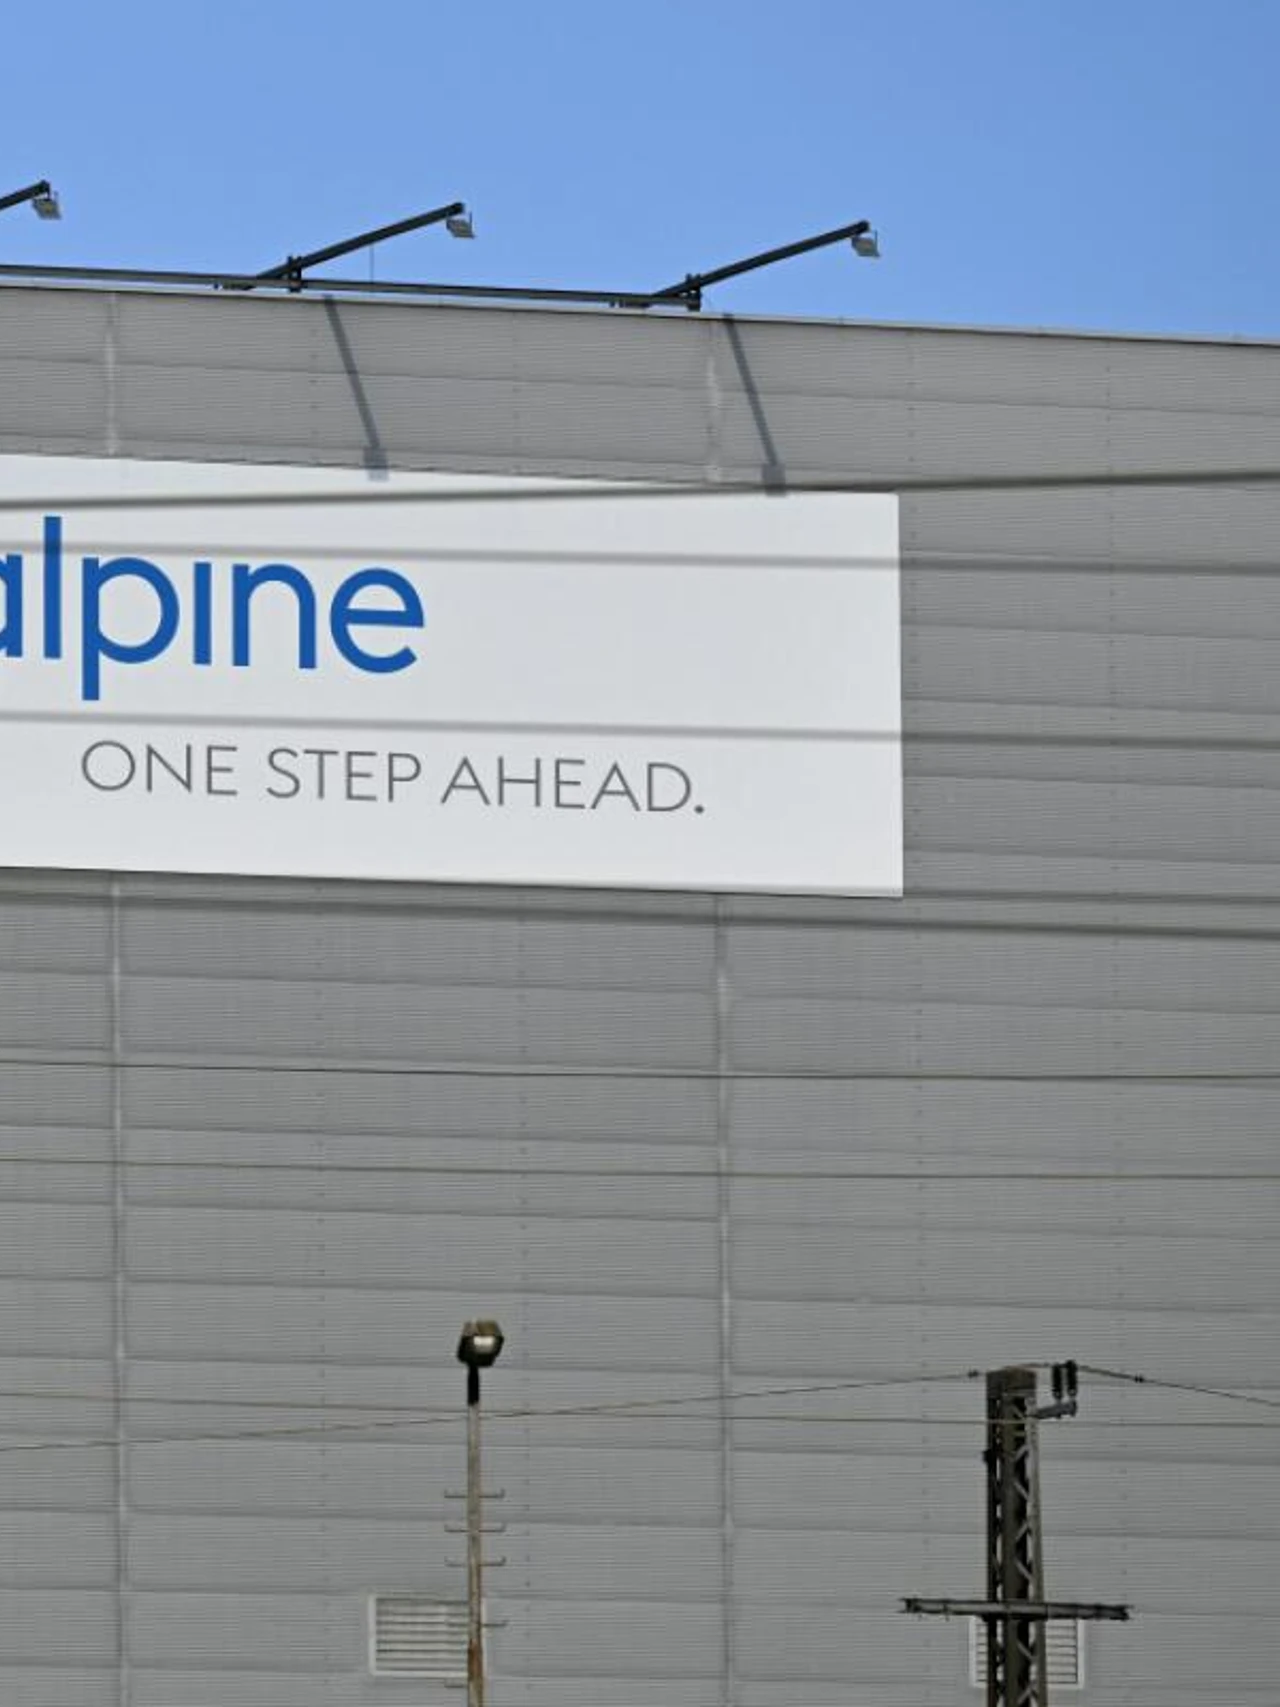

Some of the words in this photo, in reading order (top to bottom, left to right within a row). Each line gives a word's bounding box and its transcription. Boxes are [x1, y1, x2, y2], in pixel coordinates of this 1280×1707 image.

[80, 739, 239, 797] ONE
[266, 746, 422, 803] STEP
[440, 755, 705, 815] AHEAD.
